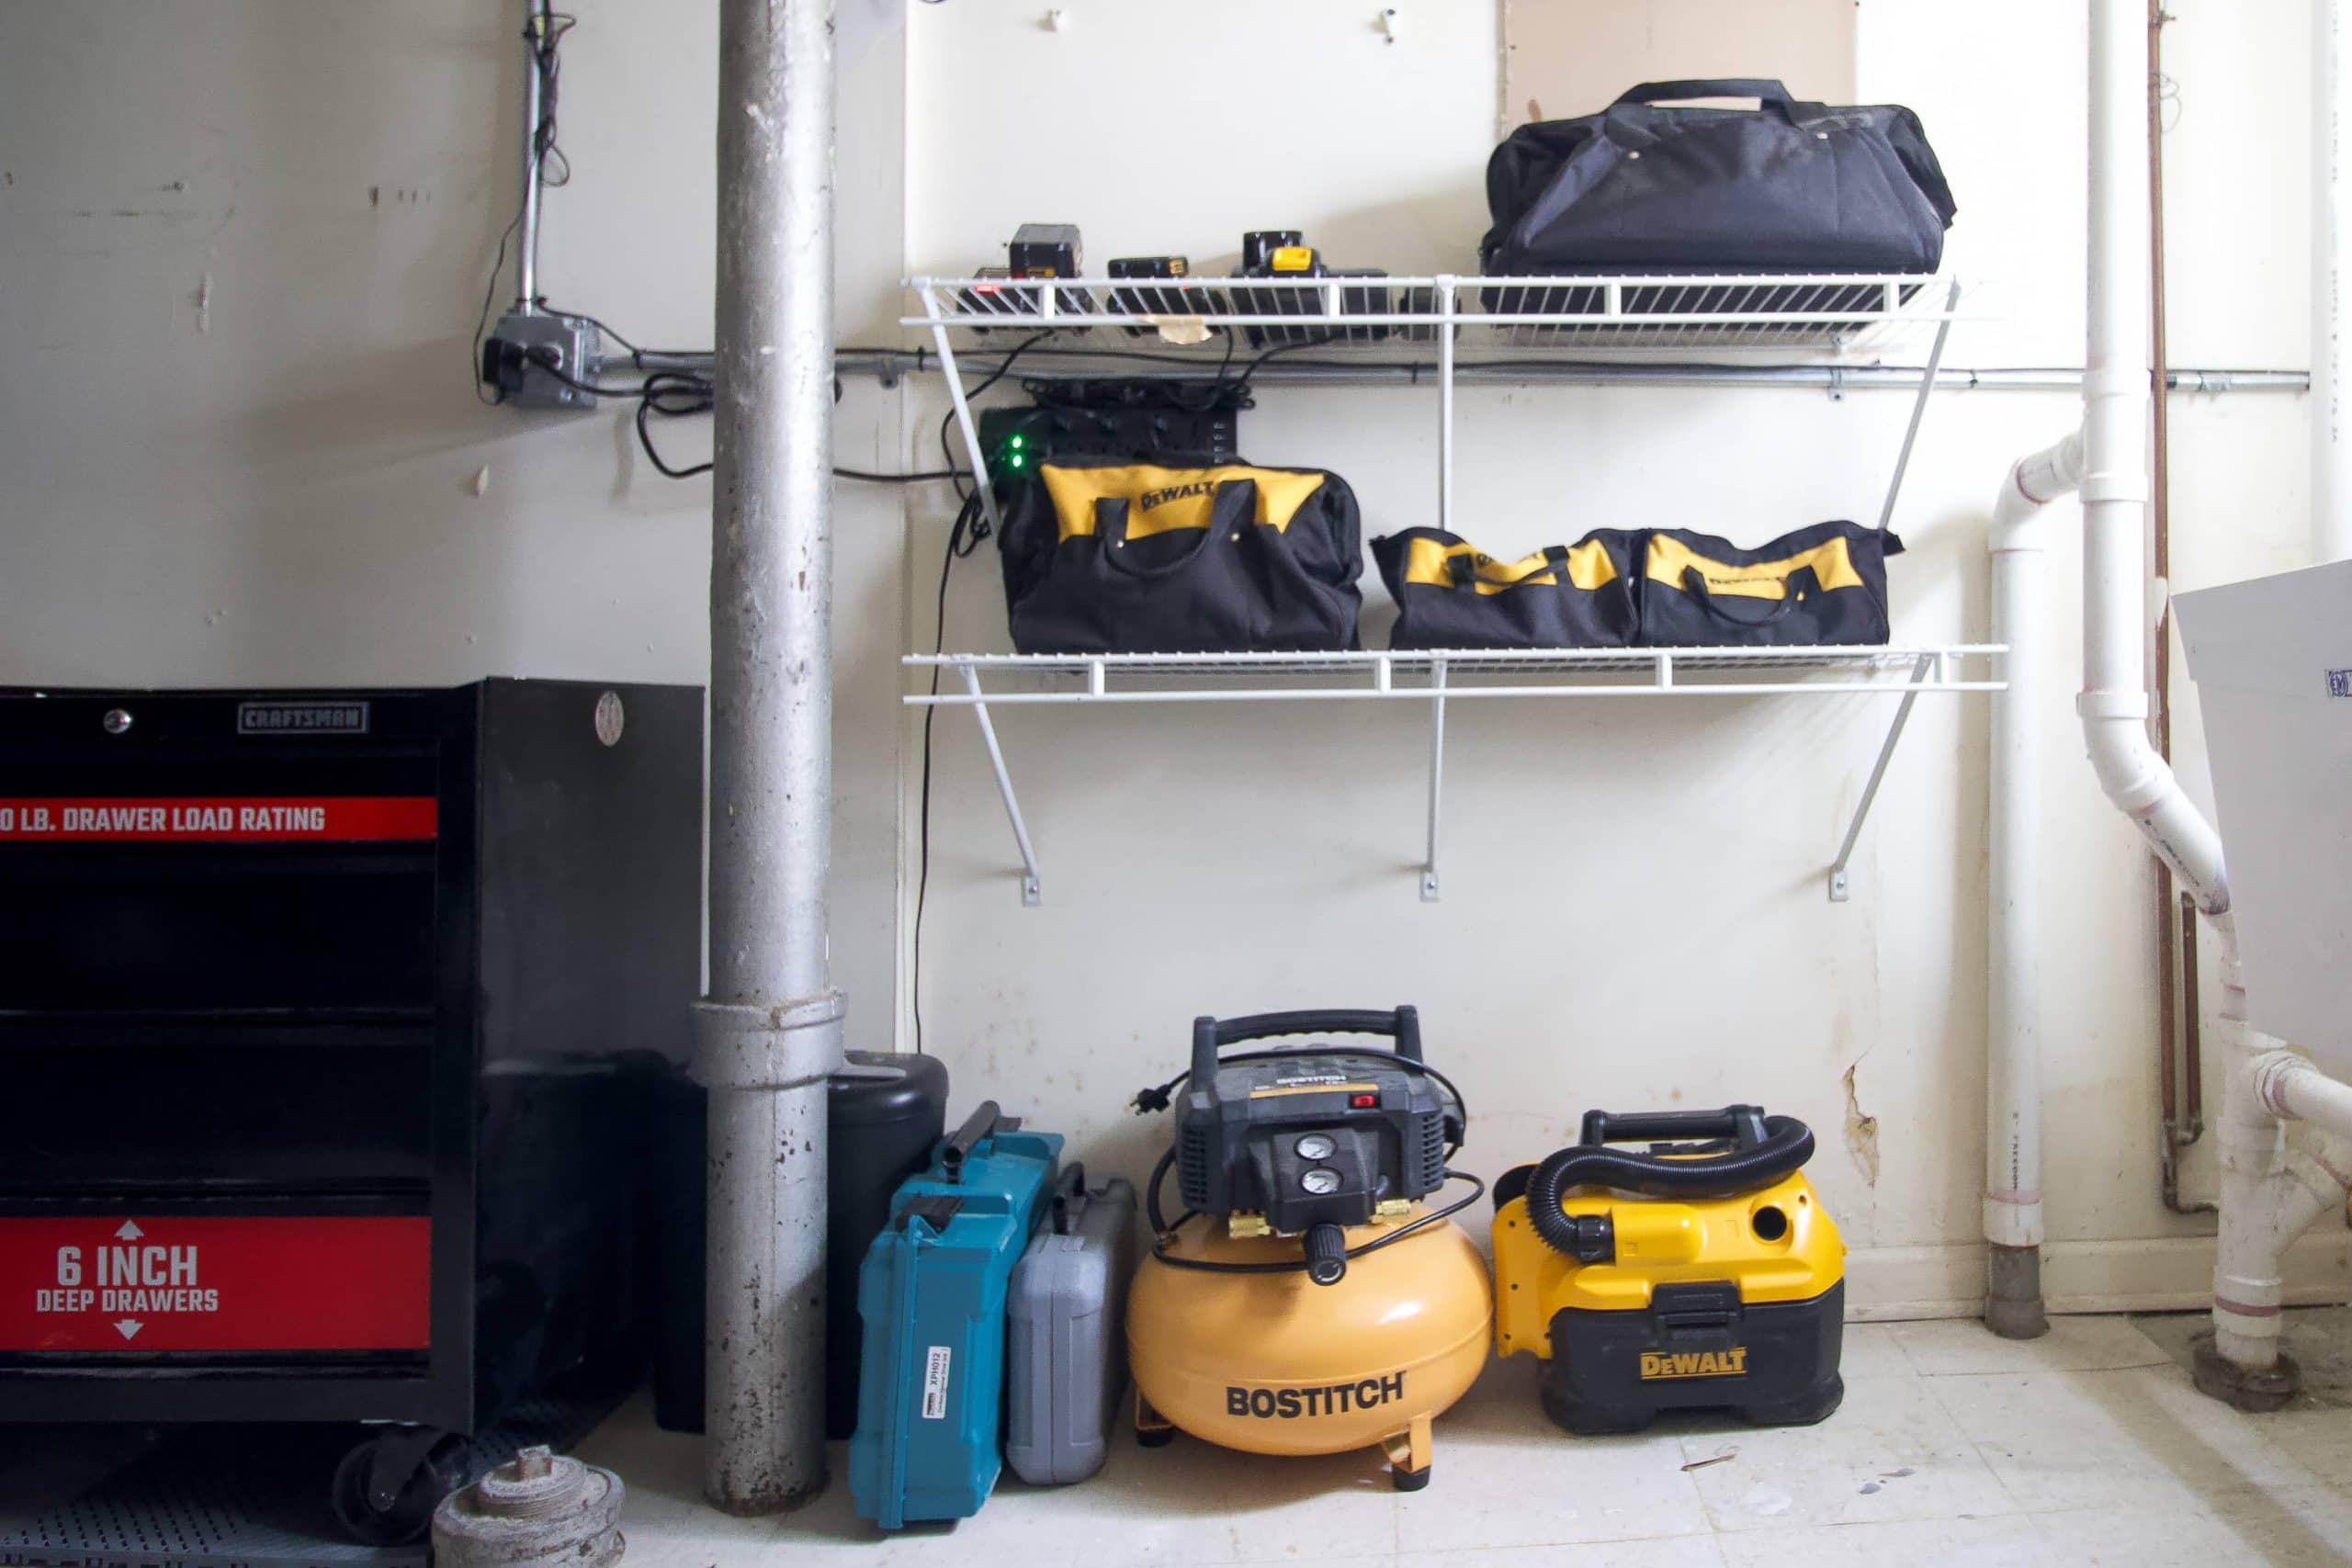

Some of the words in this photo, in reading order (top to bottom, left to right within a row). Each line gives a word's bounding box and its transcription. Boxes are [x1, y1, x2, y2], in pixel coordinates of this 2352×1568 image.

[244, 708, 359, 728] CRAFTSMAN
[21, 807, 56, 831] LB.
[63, 807, 166, 831] DRAWER
[174, 807, 233, 831] LOAD
[241, 807, 325, 831] RATING
[57, 1246, 82, 1286] 6
[96, 1246, 198, 1286] INCH
[37, 1289, 95, 1312] DEEP
[102, 1289, 219, 1312] DRAWERS
[930, 1353, 941, 1385] XPH012
[1640, 1351, 1747, 1379] DEWALT
[1226, 1370, 1408, 1418] BOSTITCH
